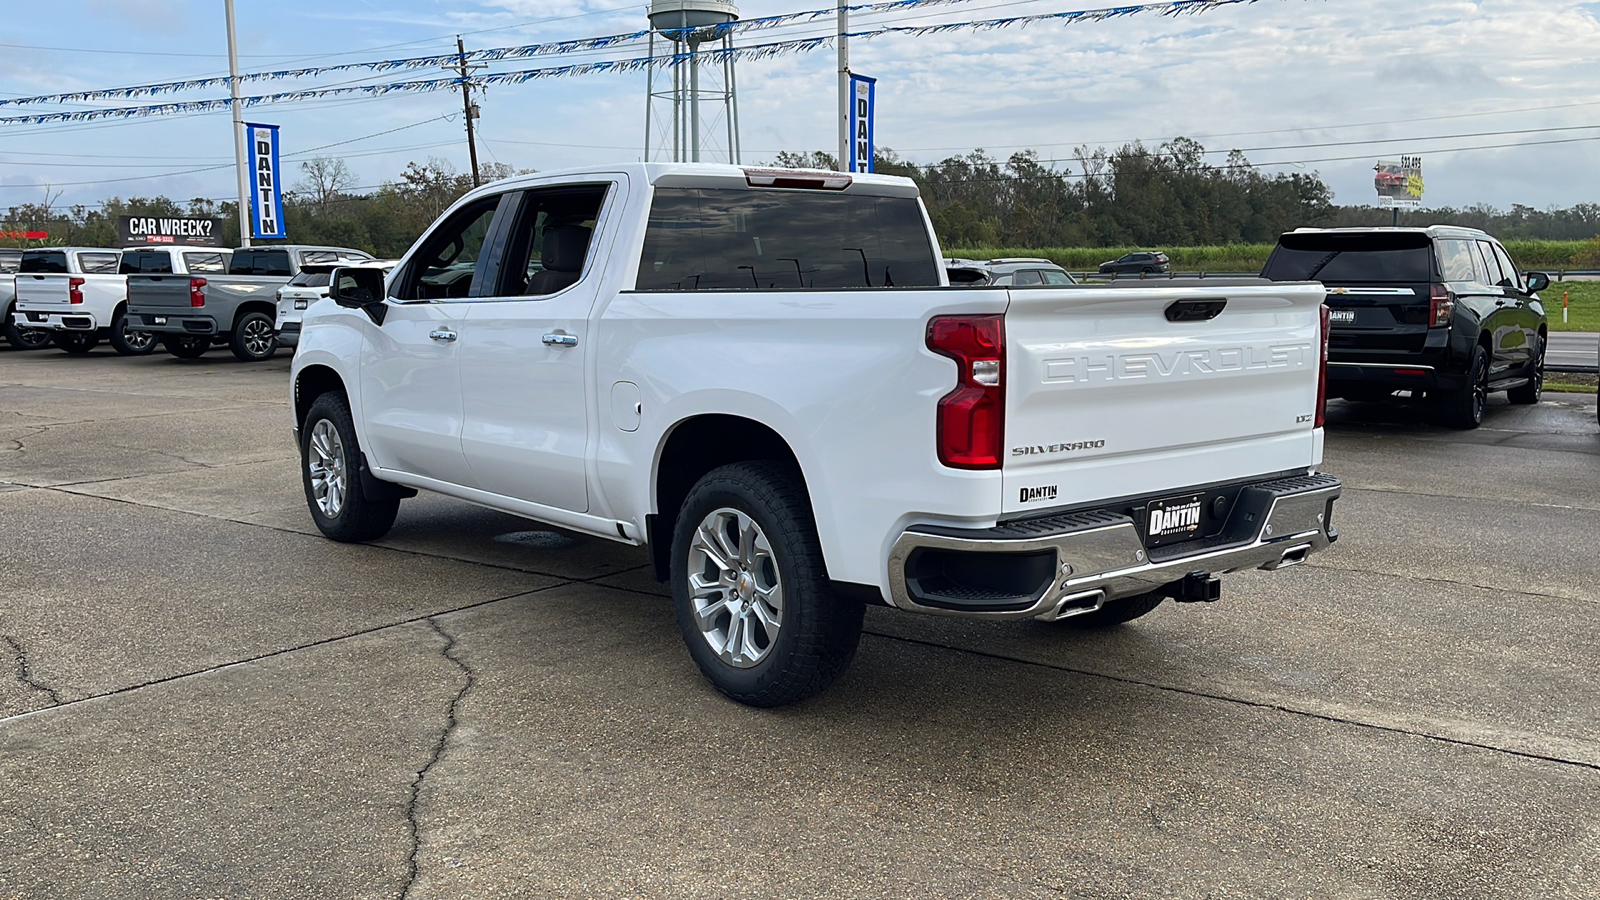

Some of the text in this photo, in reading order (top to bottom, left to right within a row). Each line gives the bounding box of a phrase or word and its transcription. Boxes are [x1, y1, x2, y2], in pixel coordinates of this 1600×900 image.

[257, 141, 275, 233] DANTIN
[129, 218, 213, 236] CAR WRECK?
[1041, 342, 1311, 385] CHEVROLET
[1012, 440, 1105, 456] SILVERADO
[1020, 485, 1057, 503] DANTIN
[1149, 507, 1201, 535] DANTIN
